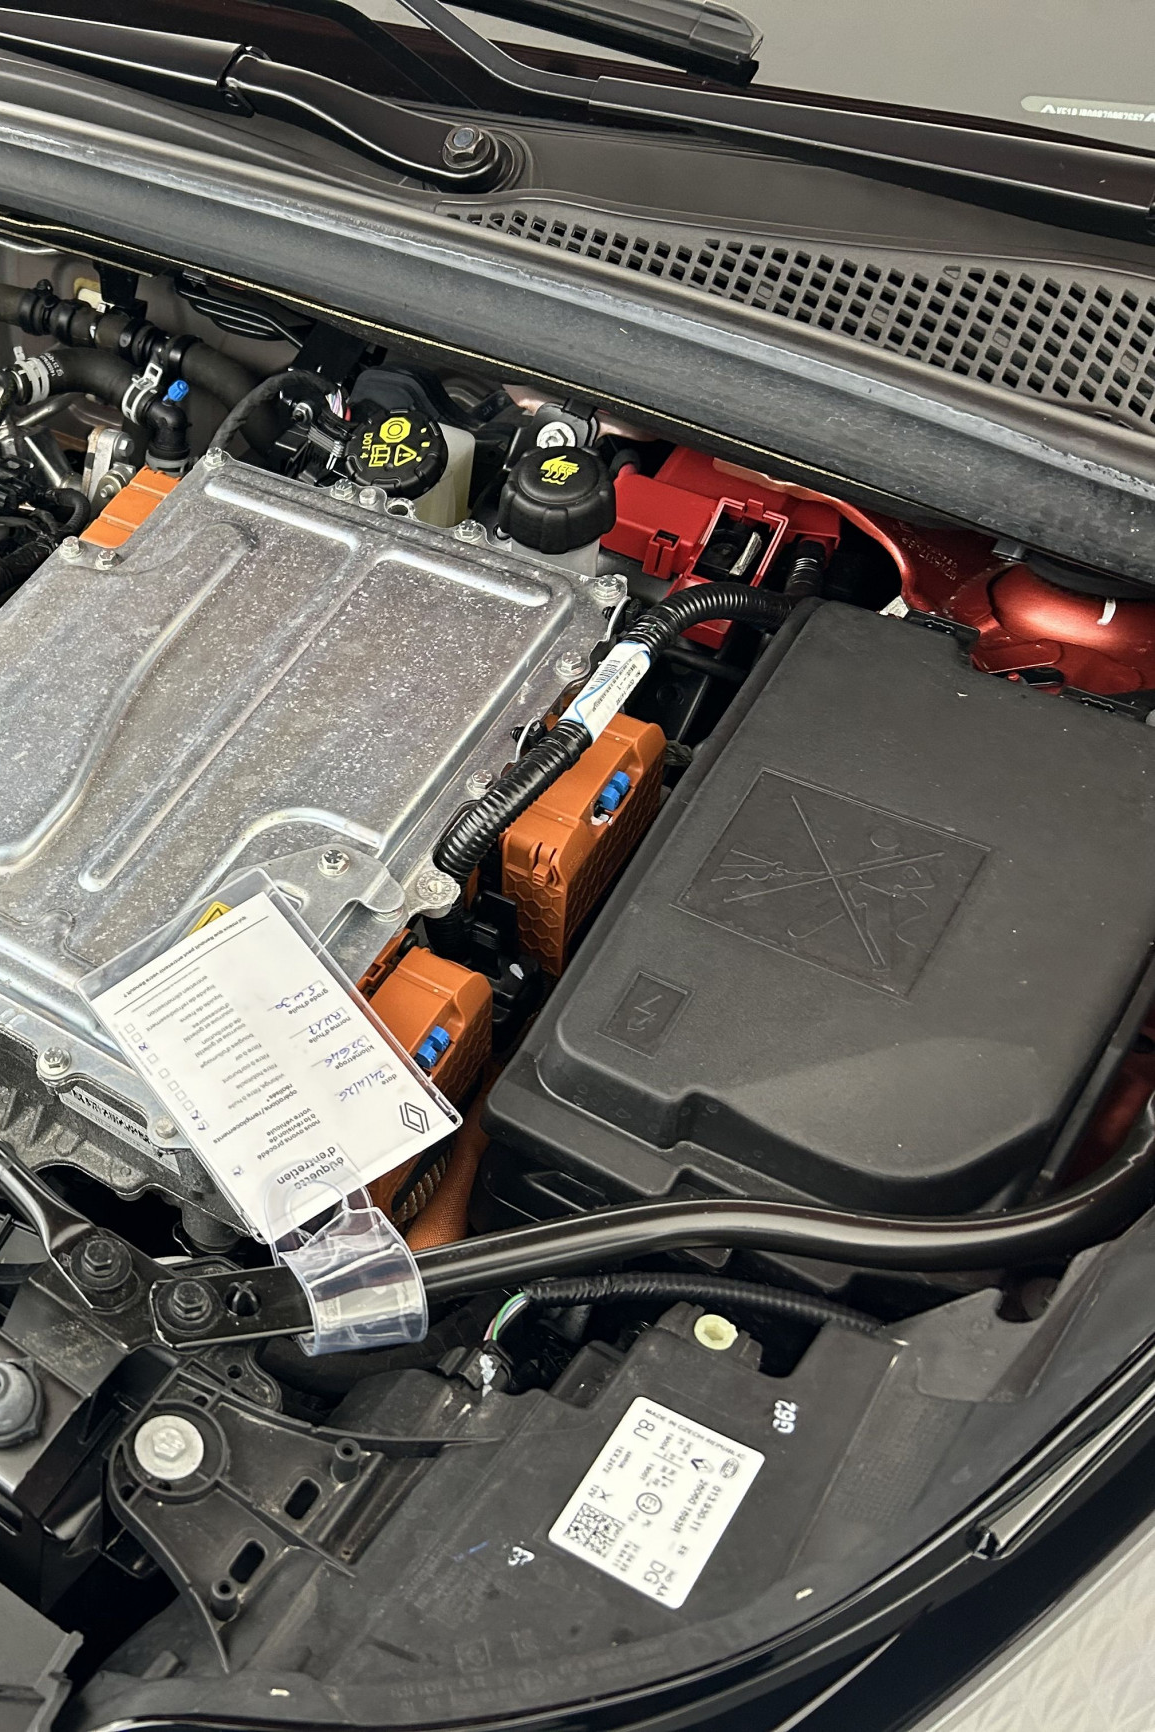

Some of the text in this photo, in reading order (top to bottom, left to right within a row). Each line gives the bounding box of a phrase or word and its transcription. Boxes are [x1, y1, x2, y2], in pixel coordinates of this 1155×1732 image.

[362, 433, 374, 450] DOT
[181, 974, 208, 994] entretien
[145, 983, 216, 1032] liquide de refroidissement
[146, 991, 182, 1017] climatisation
[202, 992, 223, 1007] liquide
[287, 987, 328, 1015] grade d'huile
[178, 1010, 197, 1023] freins
[209, 1007, 234, 1024] courroie
[200, 1021, 234, 1045] distribution
[221, 1022, 246, 1039] courroie
[307, 1015, 351, 1043] norme d'huile
[214, 1036, 223, 1044] et
[246, 1042, 262, 1053] filtre
[199, 1032, 254, 1069] bougies d'allumage
[234, 1053, 243, 1061] air
[254, 1052, 270, 1063] filtre
[334, 1044, 374, 1069] kilométrage
[221, 1063, 251, 1084] carburant
[235, 1062, 278, 1089] filtre habitacle
[259, 1072, 285, 1089] vidange,
[380, 1073, 397, 1085] date
[245, 1087, 261, 1098] filtre
[227, 1098, 243, 1109] huile
[265, 1107, 311, 1136] votre véhicule
[302, 1115, 312, 1123] la
[276, 1120, 304, 1138] révision
[256, 1118, 321, 1160] nous avons procédé
[268, 1135, 278, 1143] de
[276, 1146, 335, 1184] d'entretien
[644, 1408, 666, 1421] MADE
[632, 1418, 655, 1440] 8J
[642, 1559, 666, 1585] DG
